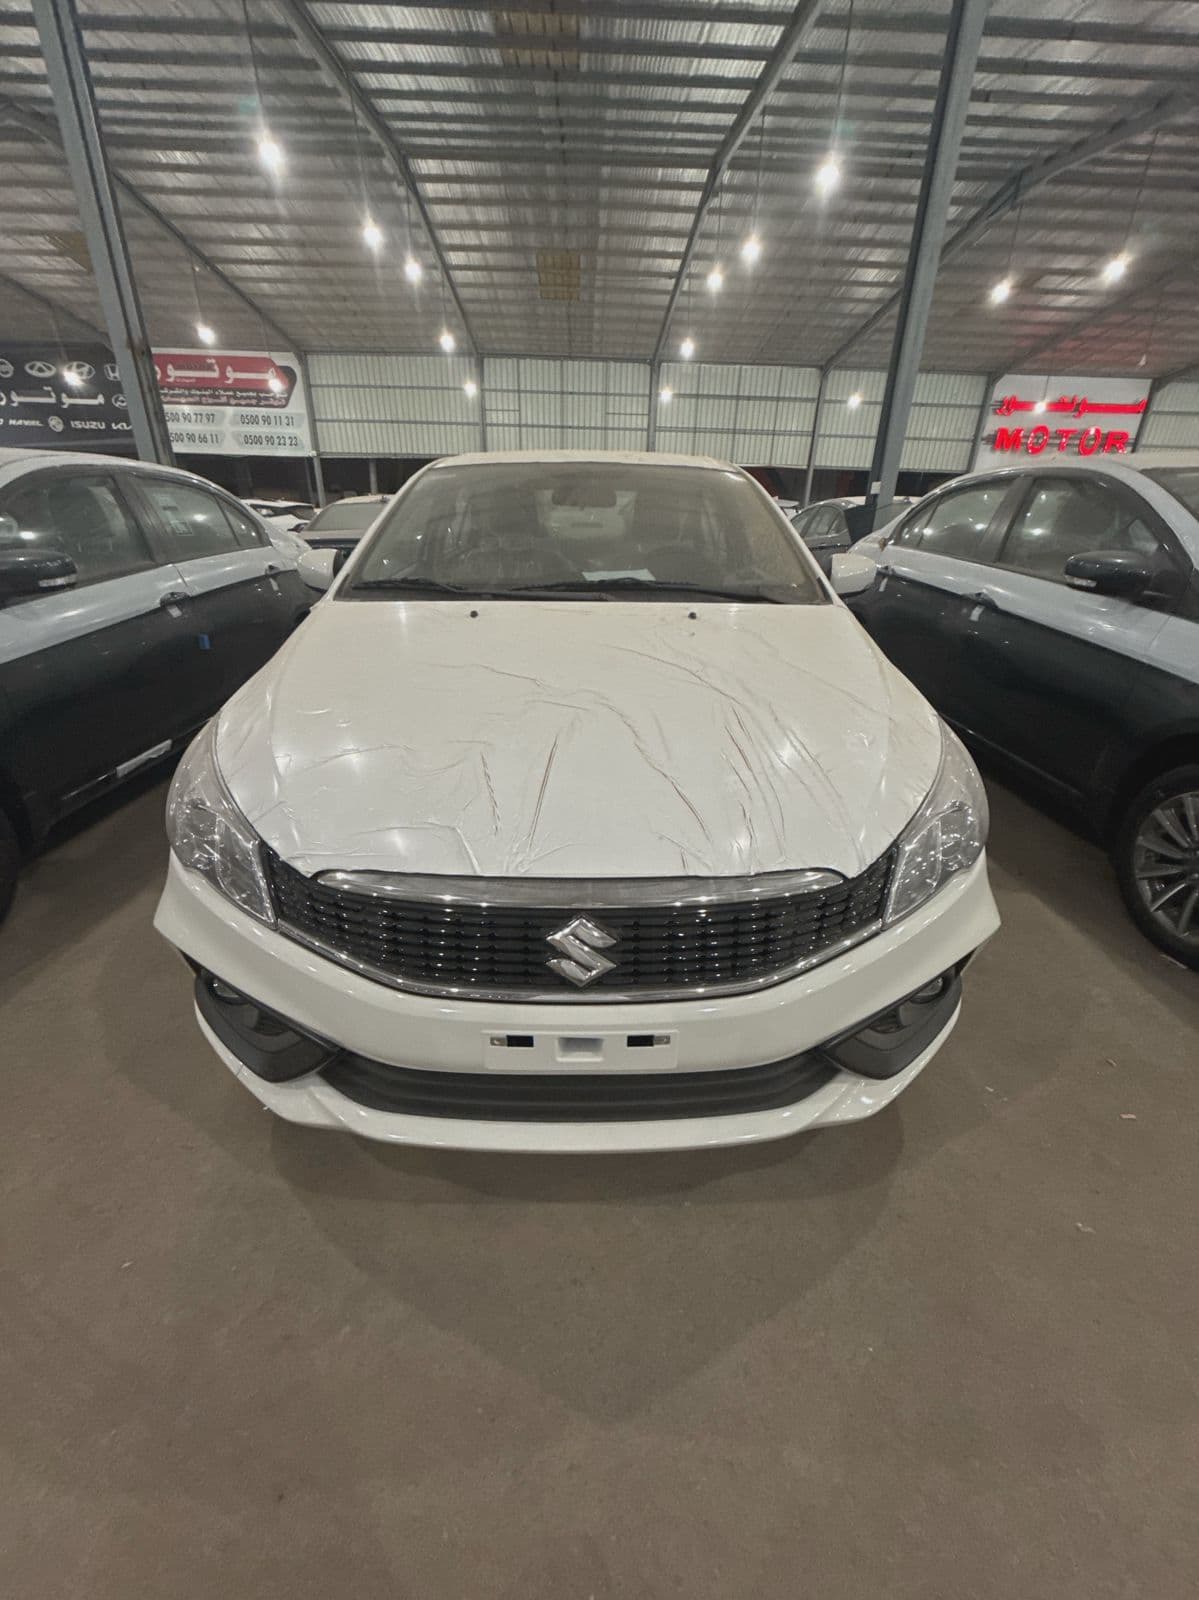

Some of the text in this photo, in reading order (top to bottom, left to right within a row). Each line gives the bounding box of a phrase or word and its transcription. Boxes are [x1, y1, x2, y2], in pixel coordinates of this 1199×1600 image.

[165, 412, 215, 424] 500 90 77 97
[240, 414, 294, 426] 0500 90 11 31
[70, 420, 106, 430] ISUZU
[169, 432, 219, 444] 500 90 66 11
[244, 434, 298, 447] 0500 90 23 23
[993, 425, 1131, 456] MOTOR
